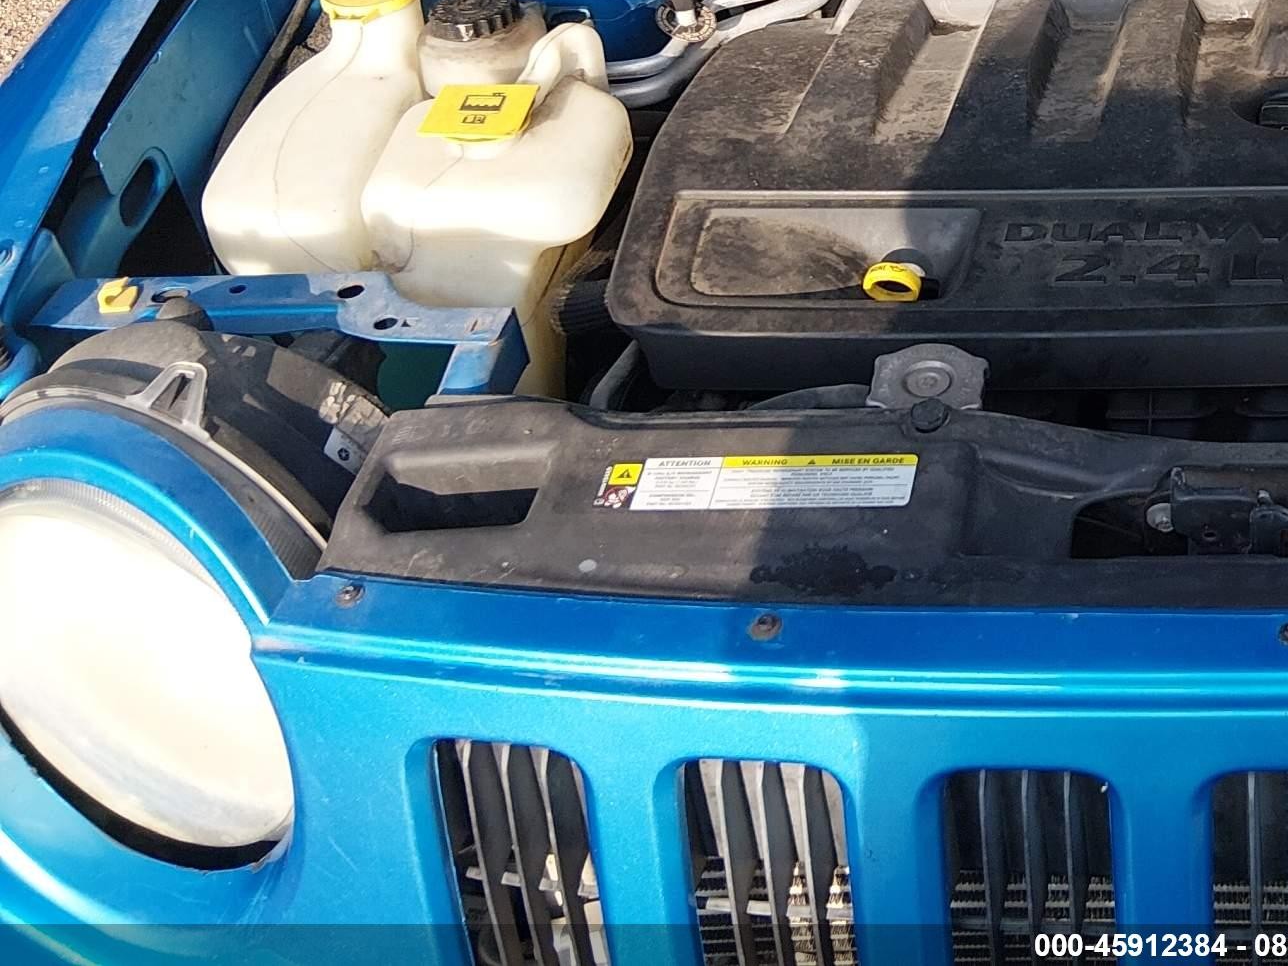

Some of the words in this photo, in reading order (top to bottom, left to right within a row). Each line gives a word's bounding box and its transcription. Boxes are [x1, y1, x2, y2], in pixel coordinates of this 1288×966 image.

[1003, 222, 1184, 244] DUAL
[658, 459, 713, 468] ATTENTION
[742, 458, 789, 466] WARNING
[831, 457, 857, 465] MISE
[872, 456, 906, 465] GARDE
